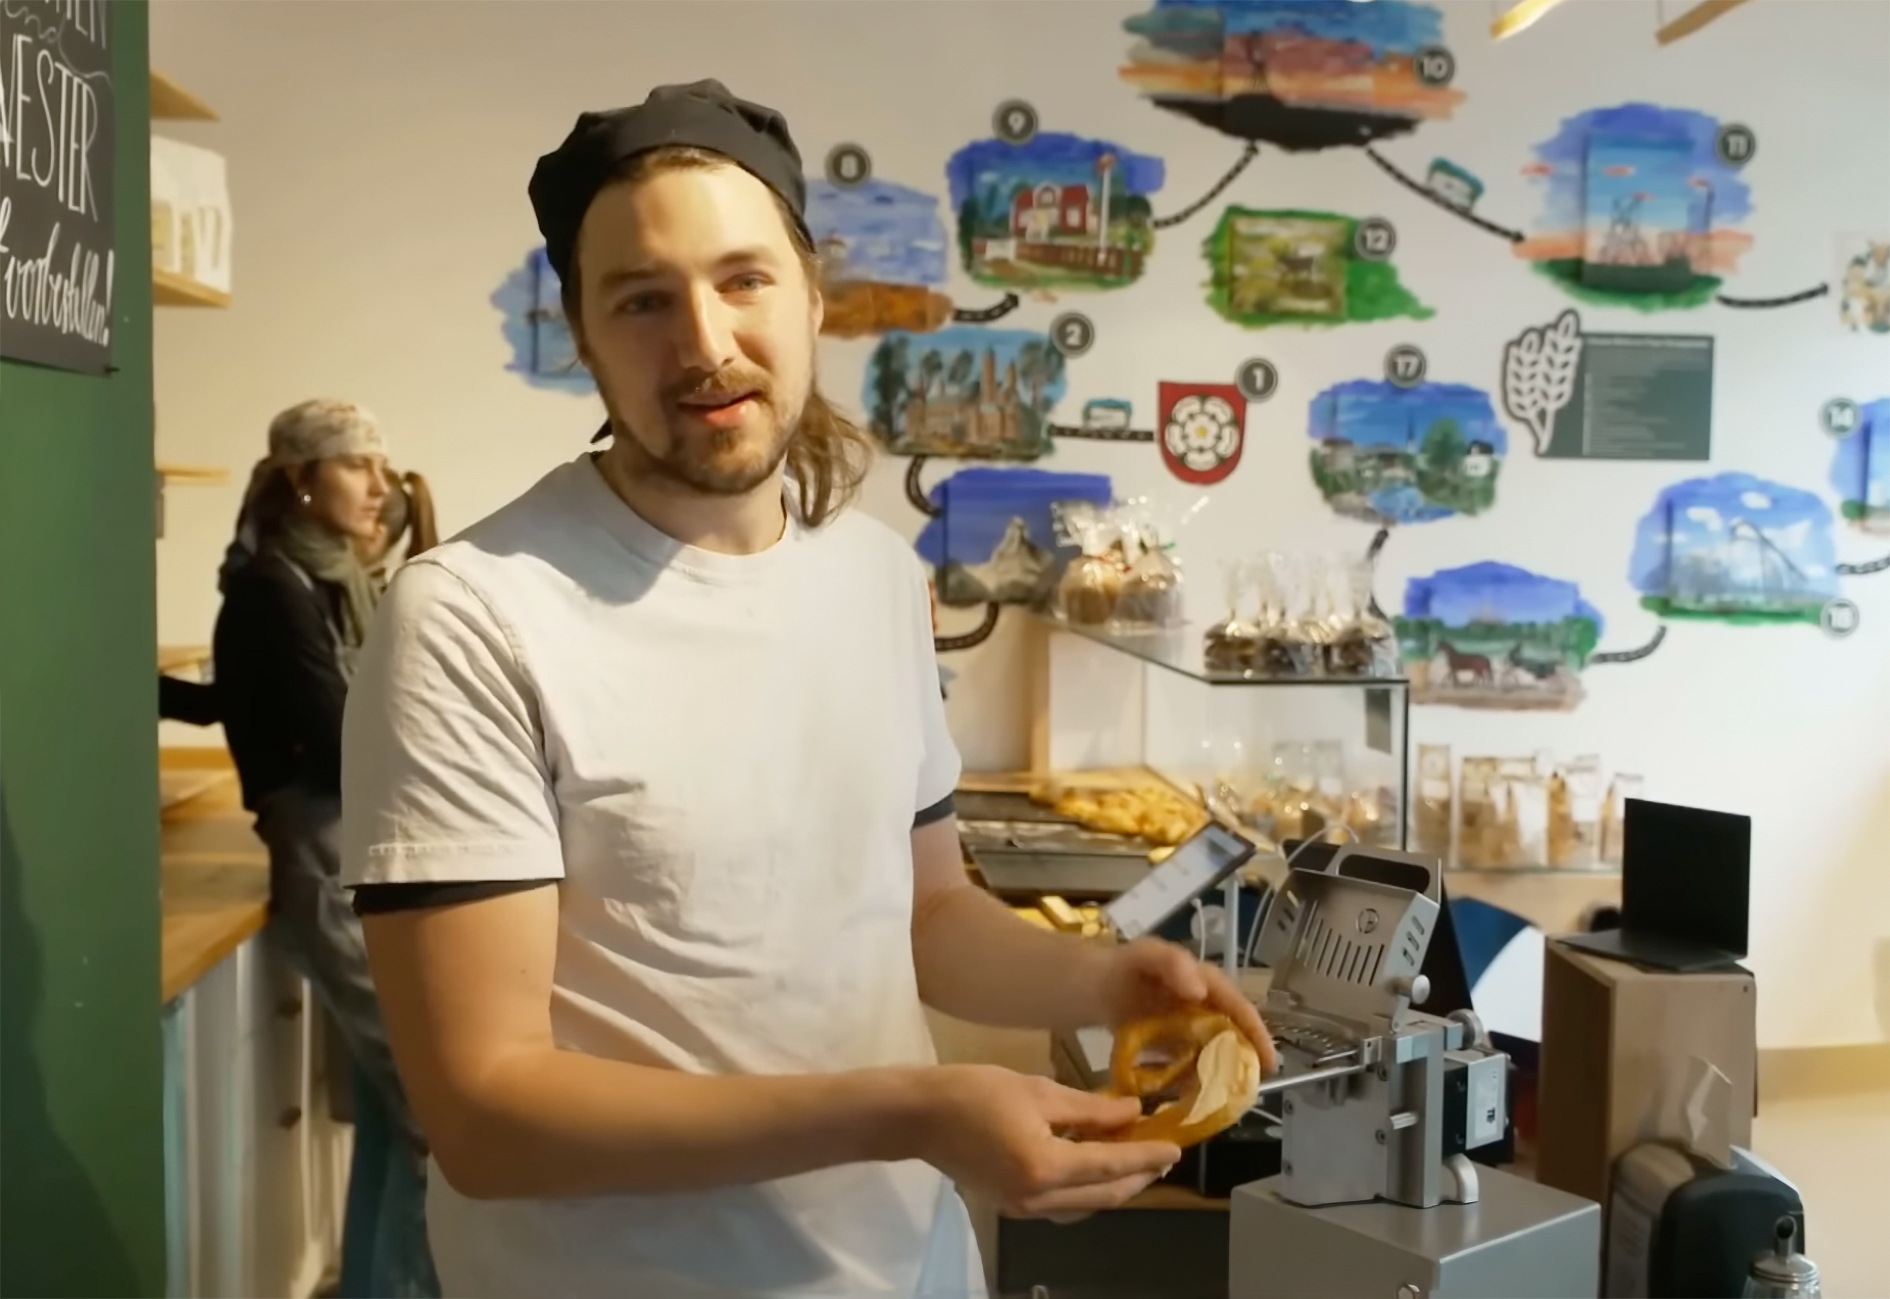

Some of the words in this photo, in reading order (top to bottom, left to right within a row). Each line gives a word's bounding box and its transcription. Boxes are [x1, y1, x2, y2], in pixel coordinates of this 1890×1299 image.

[1422, 56, 1448, 79] 10
[1008, 112, 1025, 134] 9
[1728, 134, 1748, 156] 11
[840, 155, 858, 179] 8
[1365, 229, 1390, 251] 12
[1065, 324, 1082, 346] 2
[1396, 355, 1419, 378] 17
[1252, 368, 1265, 391] 1
